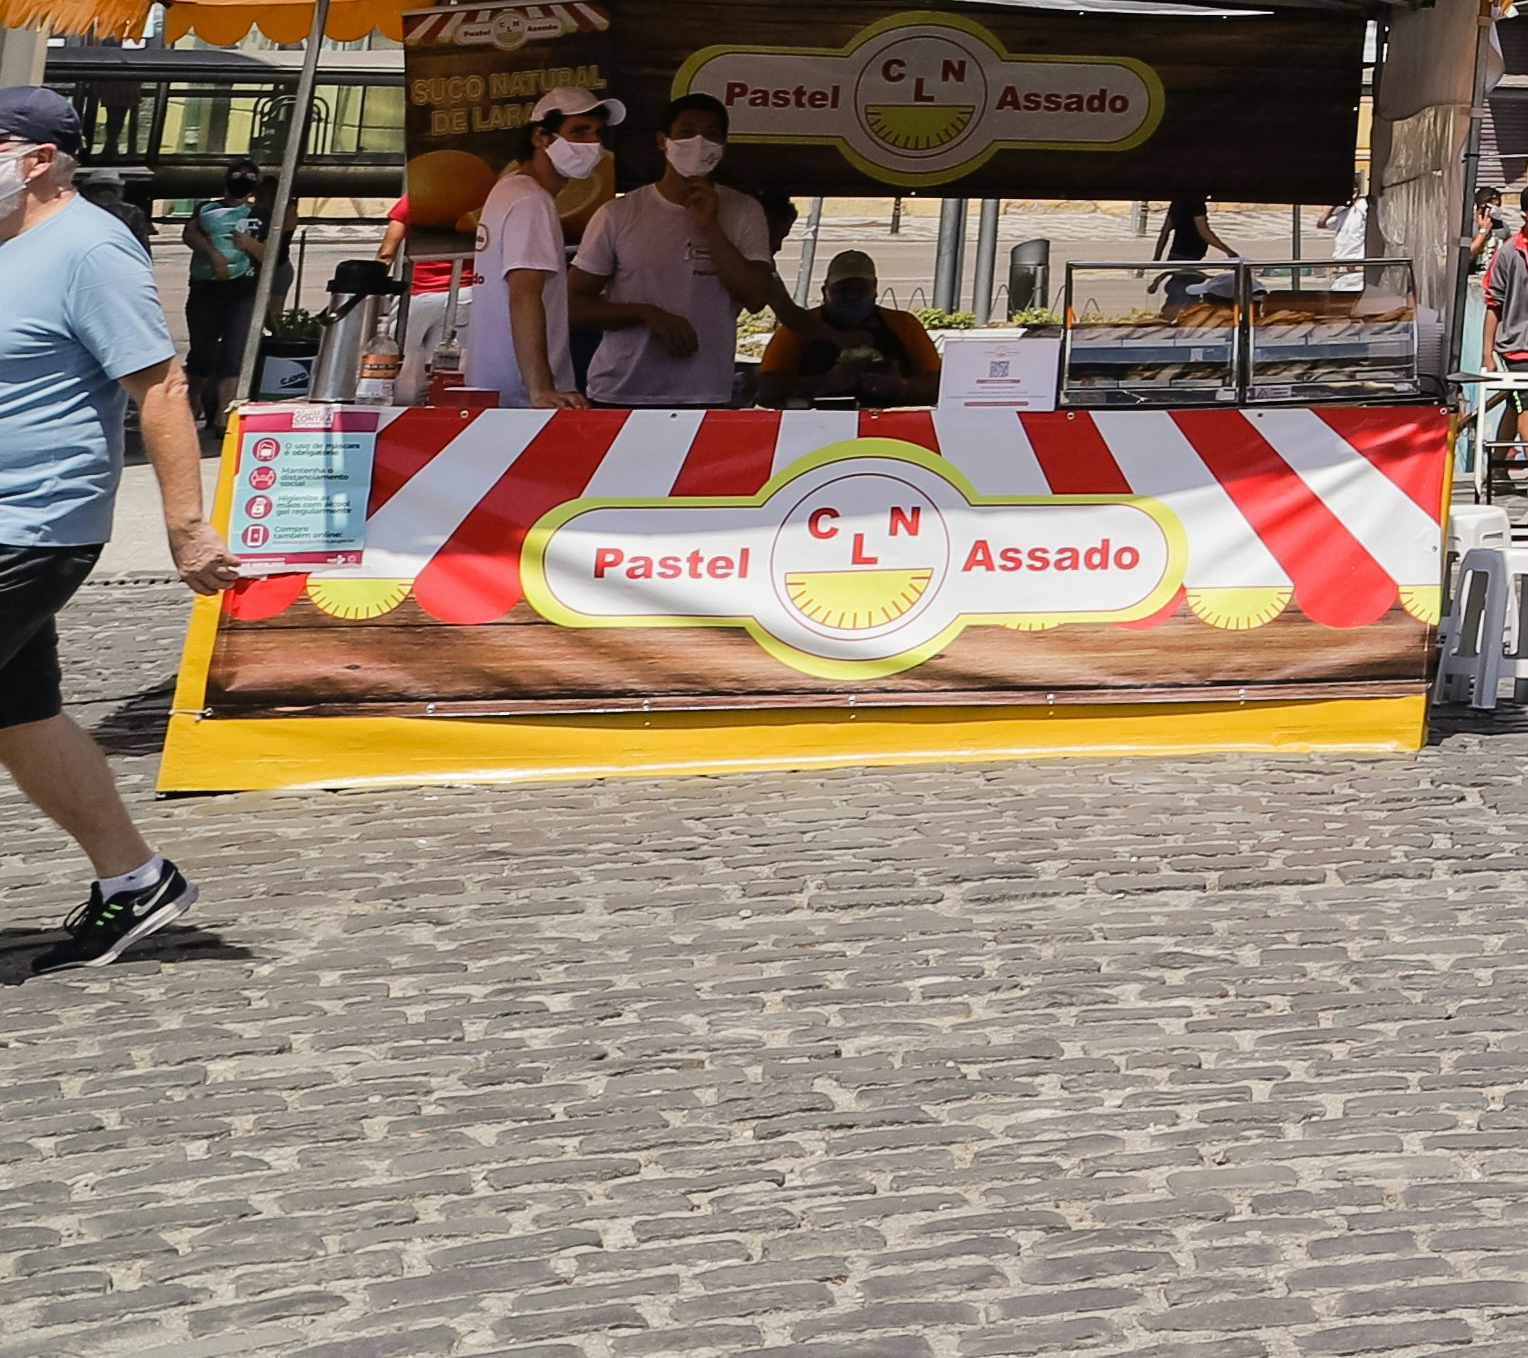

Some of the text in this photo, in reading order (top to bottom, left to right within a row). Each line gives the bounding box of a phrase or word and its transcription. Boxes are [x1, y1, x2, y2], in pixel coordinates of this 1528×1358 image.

[411, 74, 485, 106] SUCO
[724, 81, 840, 109] Pastel
[995, 85, 1130, 114] Assado
[431, 108, 469, 136] DE
[594, 548, 751, 579] Pastel
[962, 538, 1141, 573] Assado
